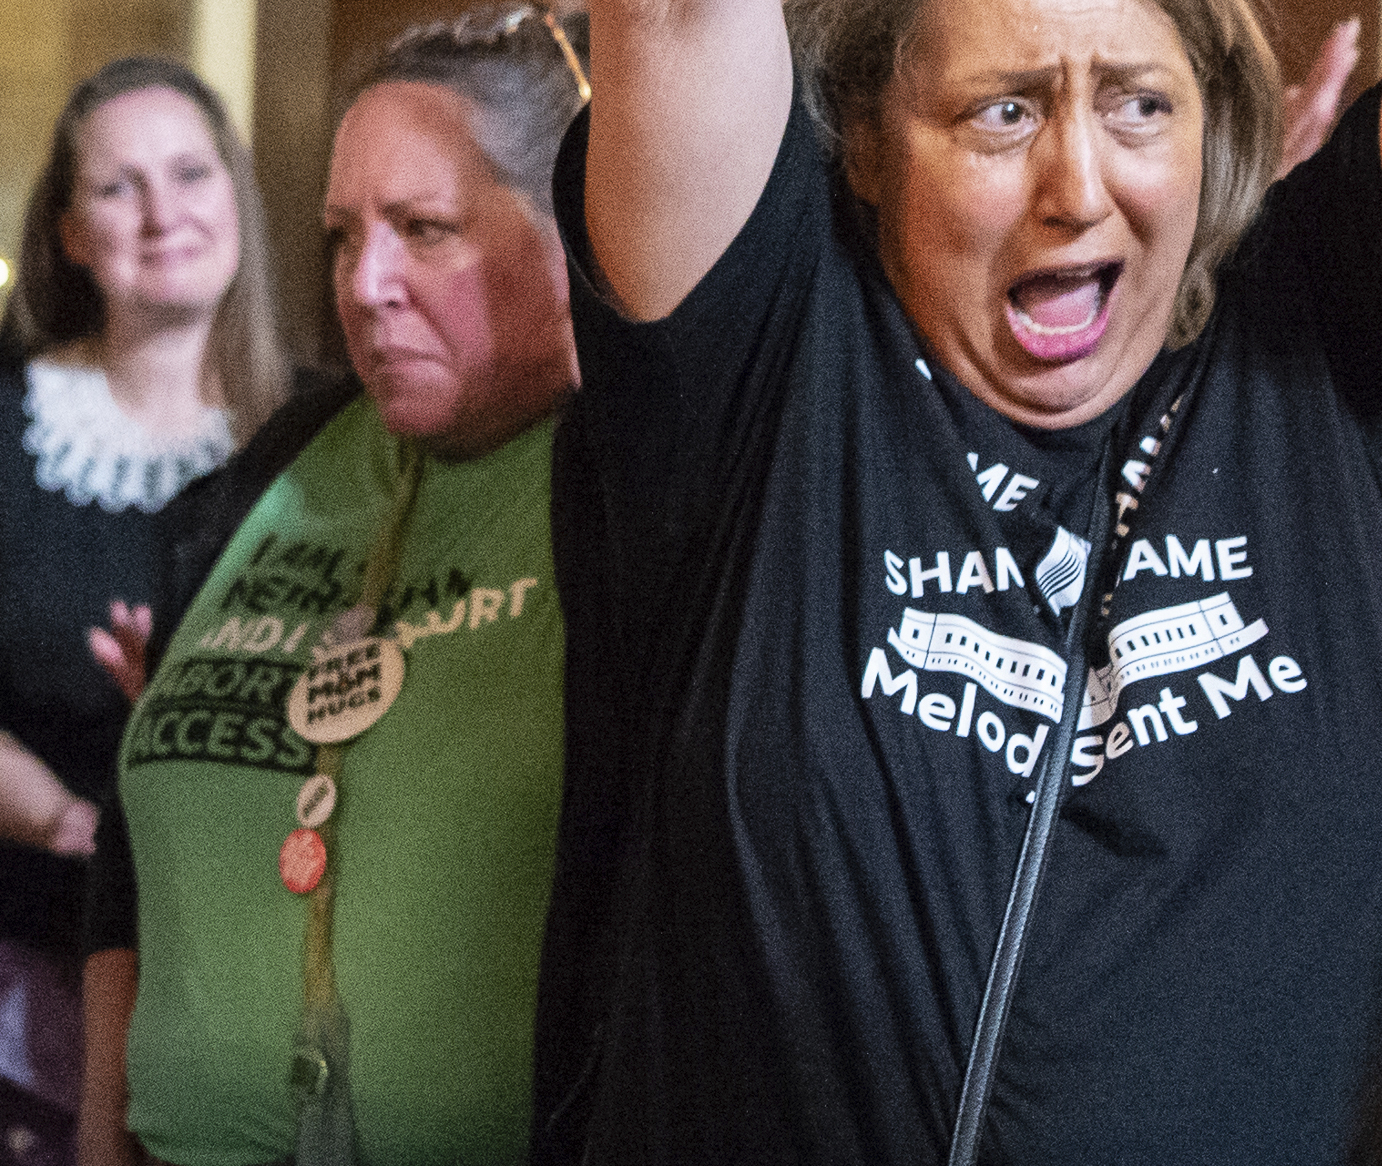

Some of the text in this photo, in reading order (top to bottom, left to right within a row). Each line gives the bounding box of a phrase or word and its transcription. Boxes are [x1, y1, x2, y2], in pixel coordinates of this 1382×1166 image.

[884, 534, 1254, 598] SHAM AME
[861, 646, 1050, 800] Melod
[1197, 653, 1308, 721] Me
